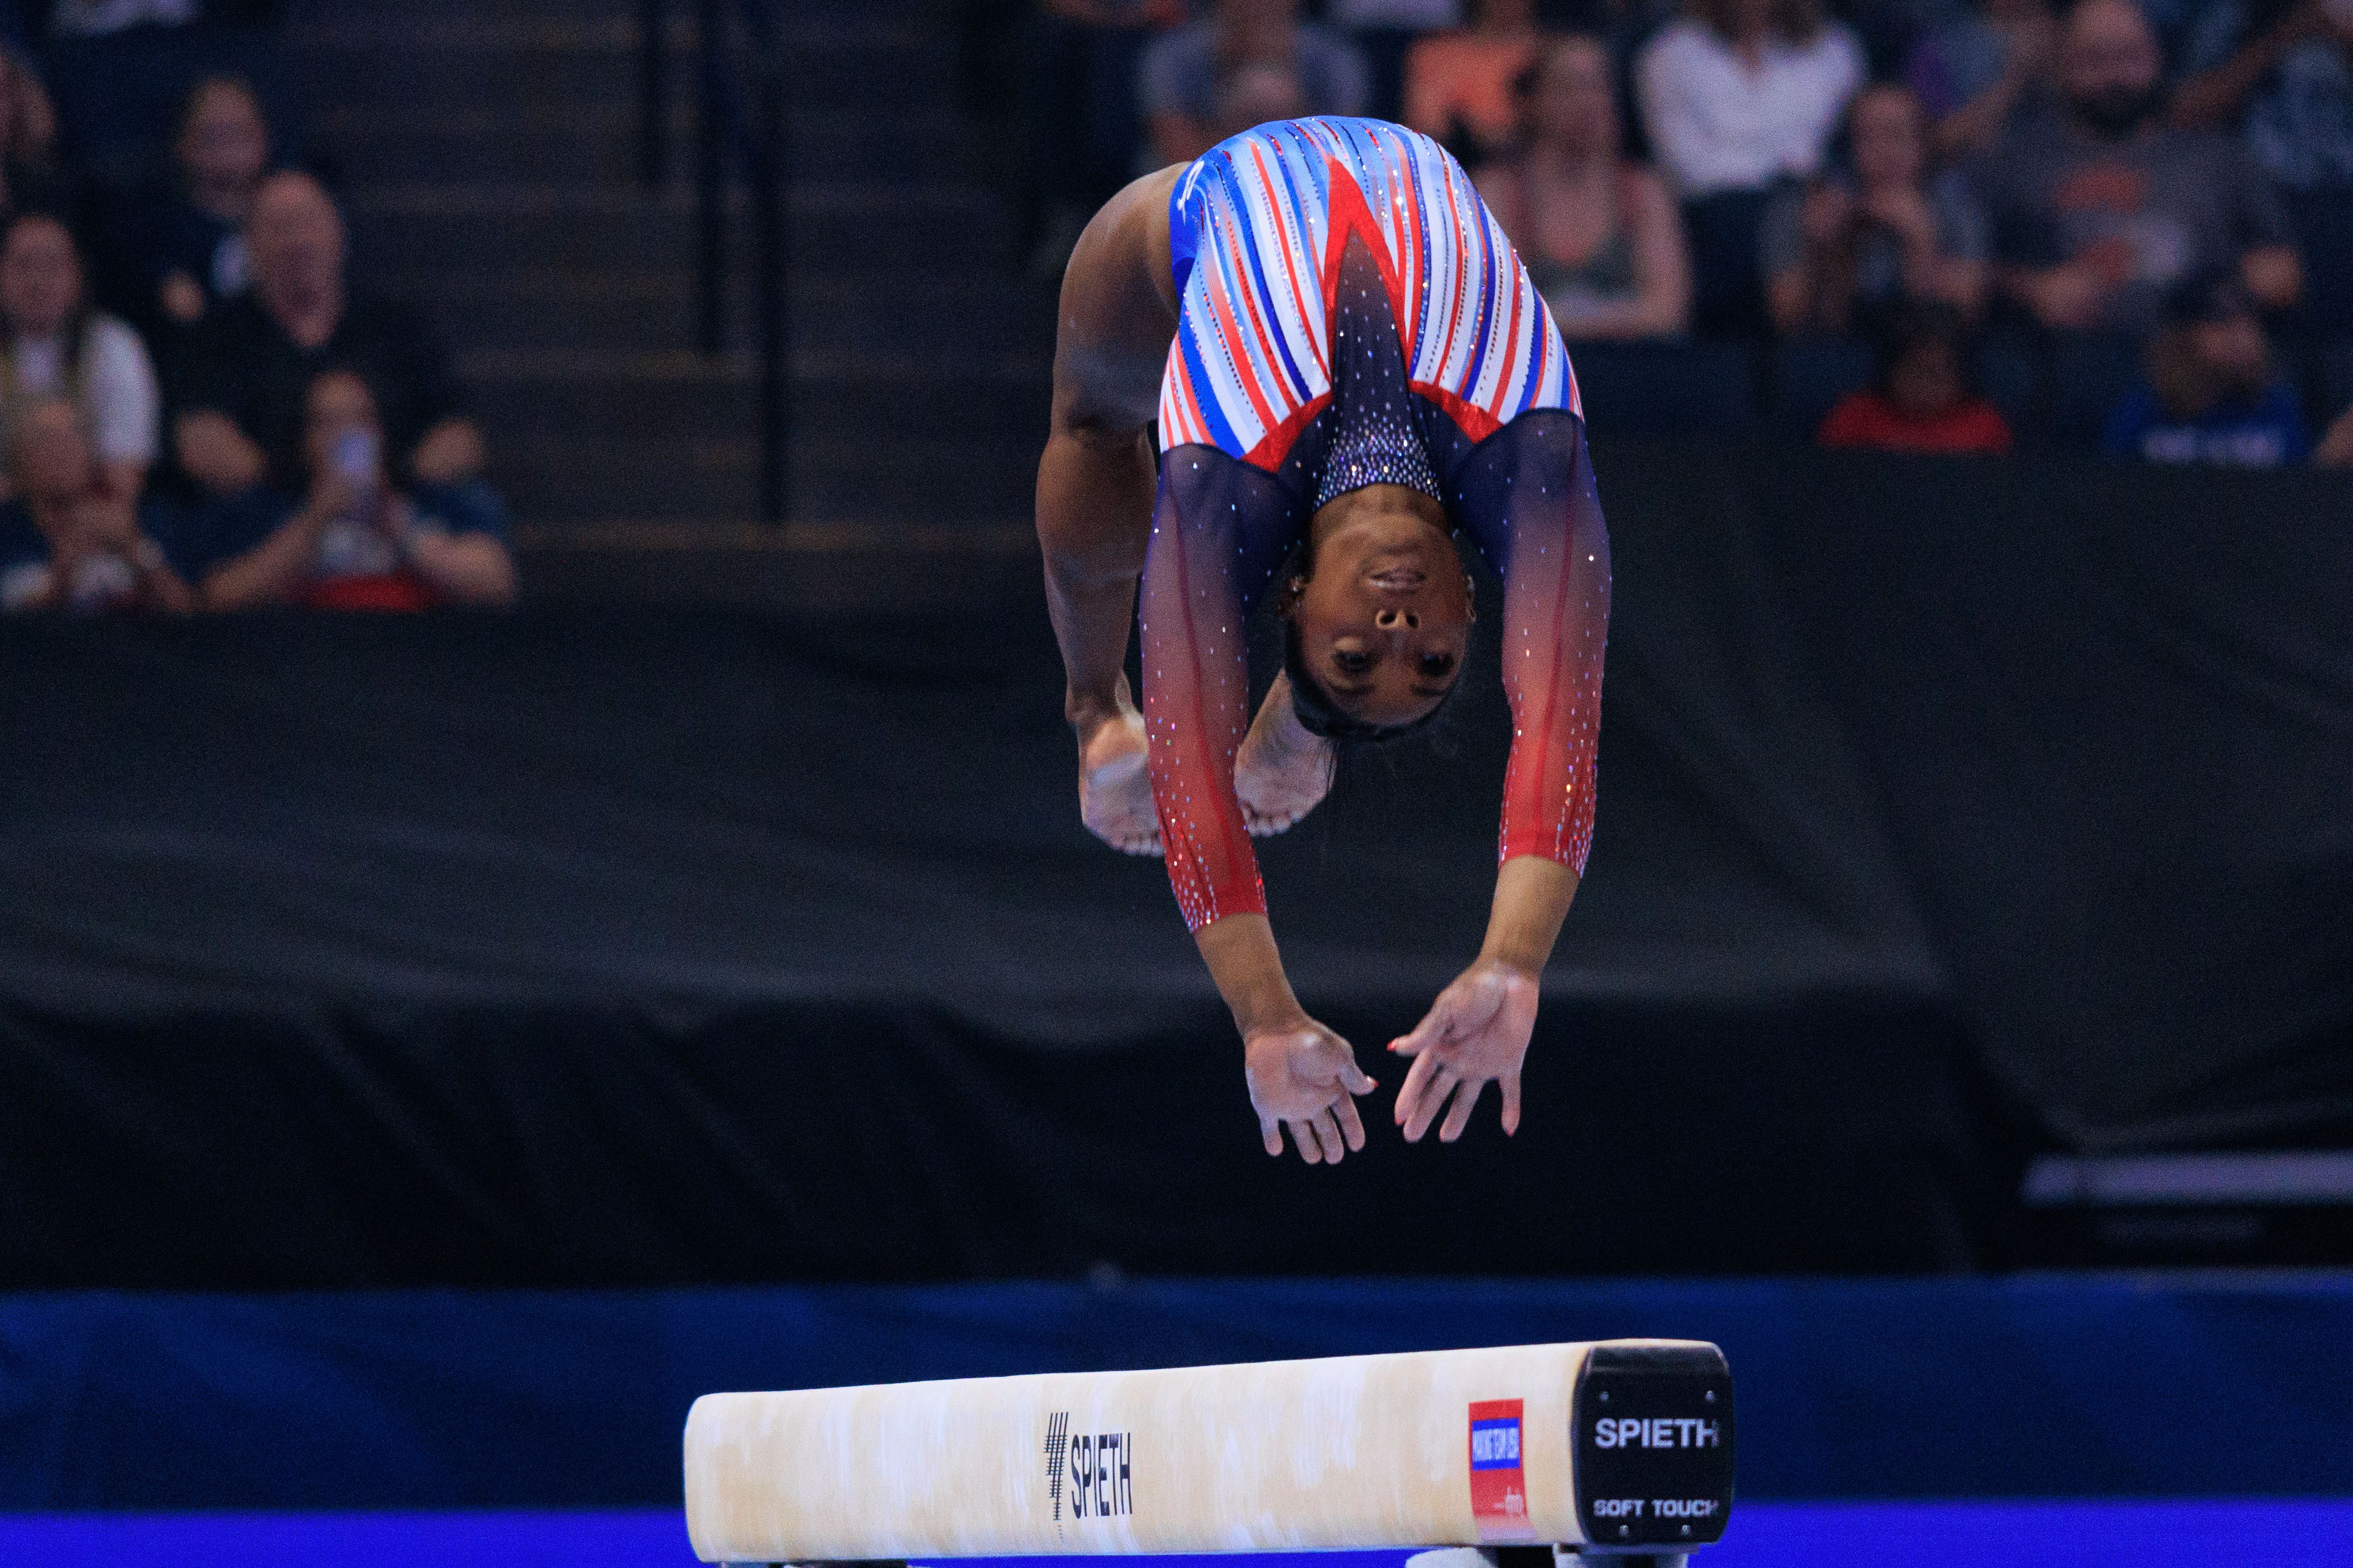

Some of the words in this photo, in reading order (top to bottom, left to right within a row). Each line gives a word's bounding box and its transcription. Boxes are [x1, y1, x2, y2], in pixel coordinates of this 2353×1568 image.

[1595, 1418, 1719, 1448] SPIETH
[1071, 1432, 1132, 1519] SPIETH
[1594, 1499, 1645, 1517] SOFT
